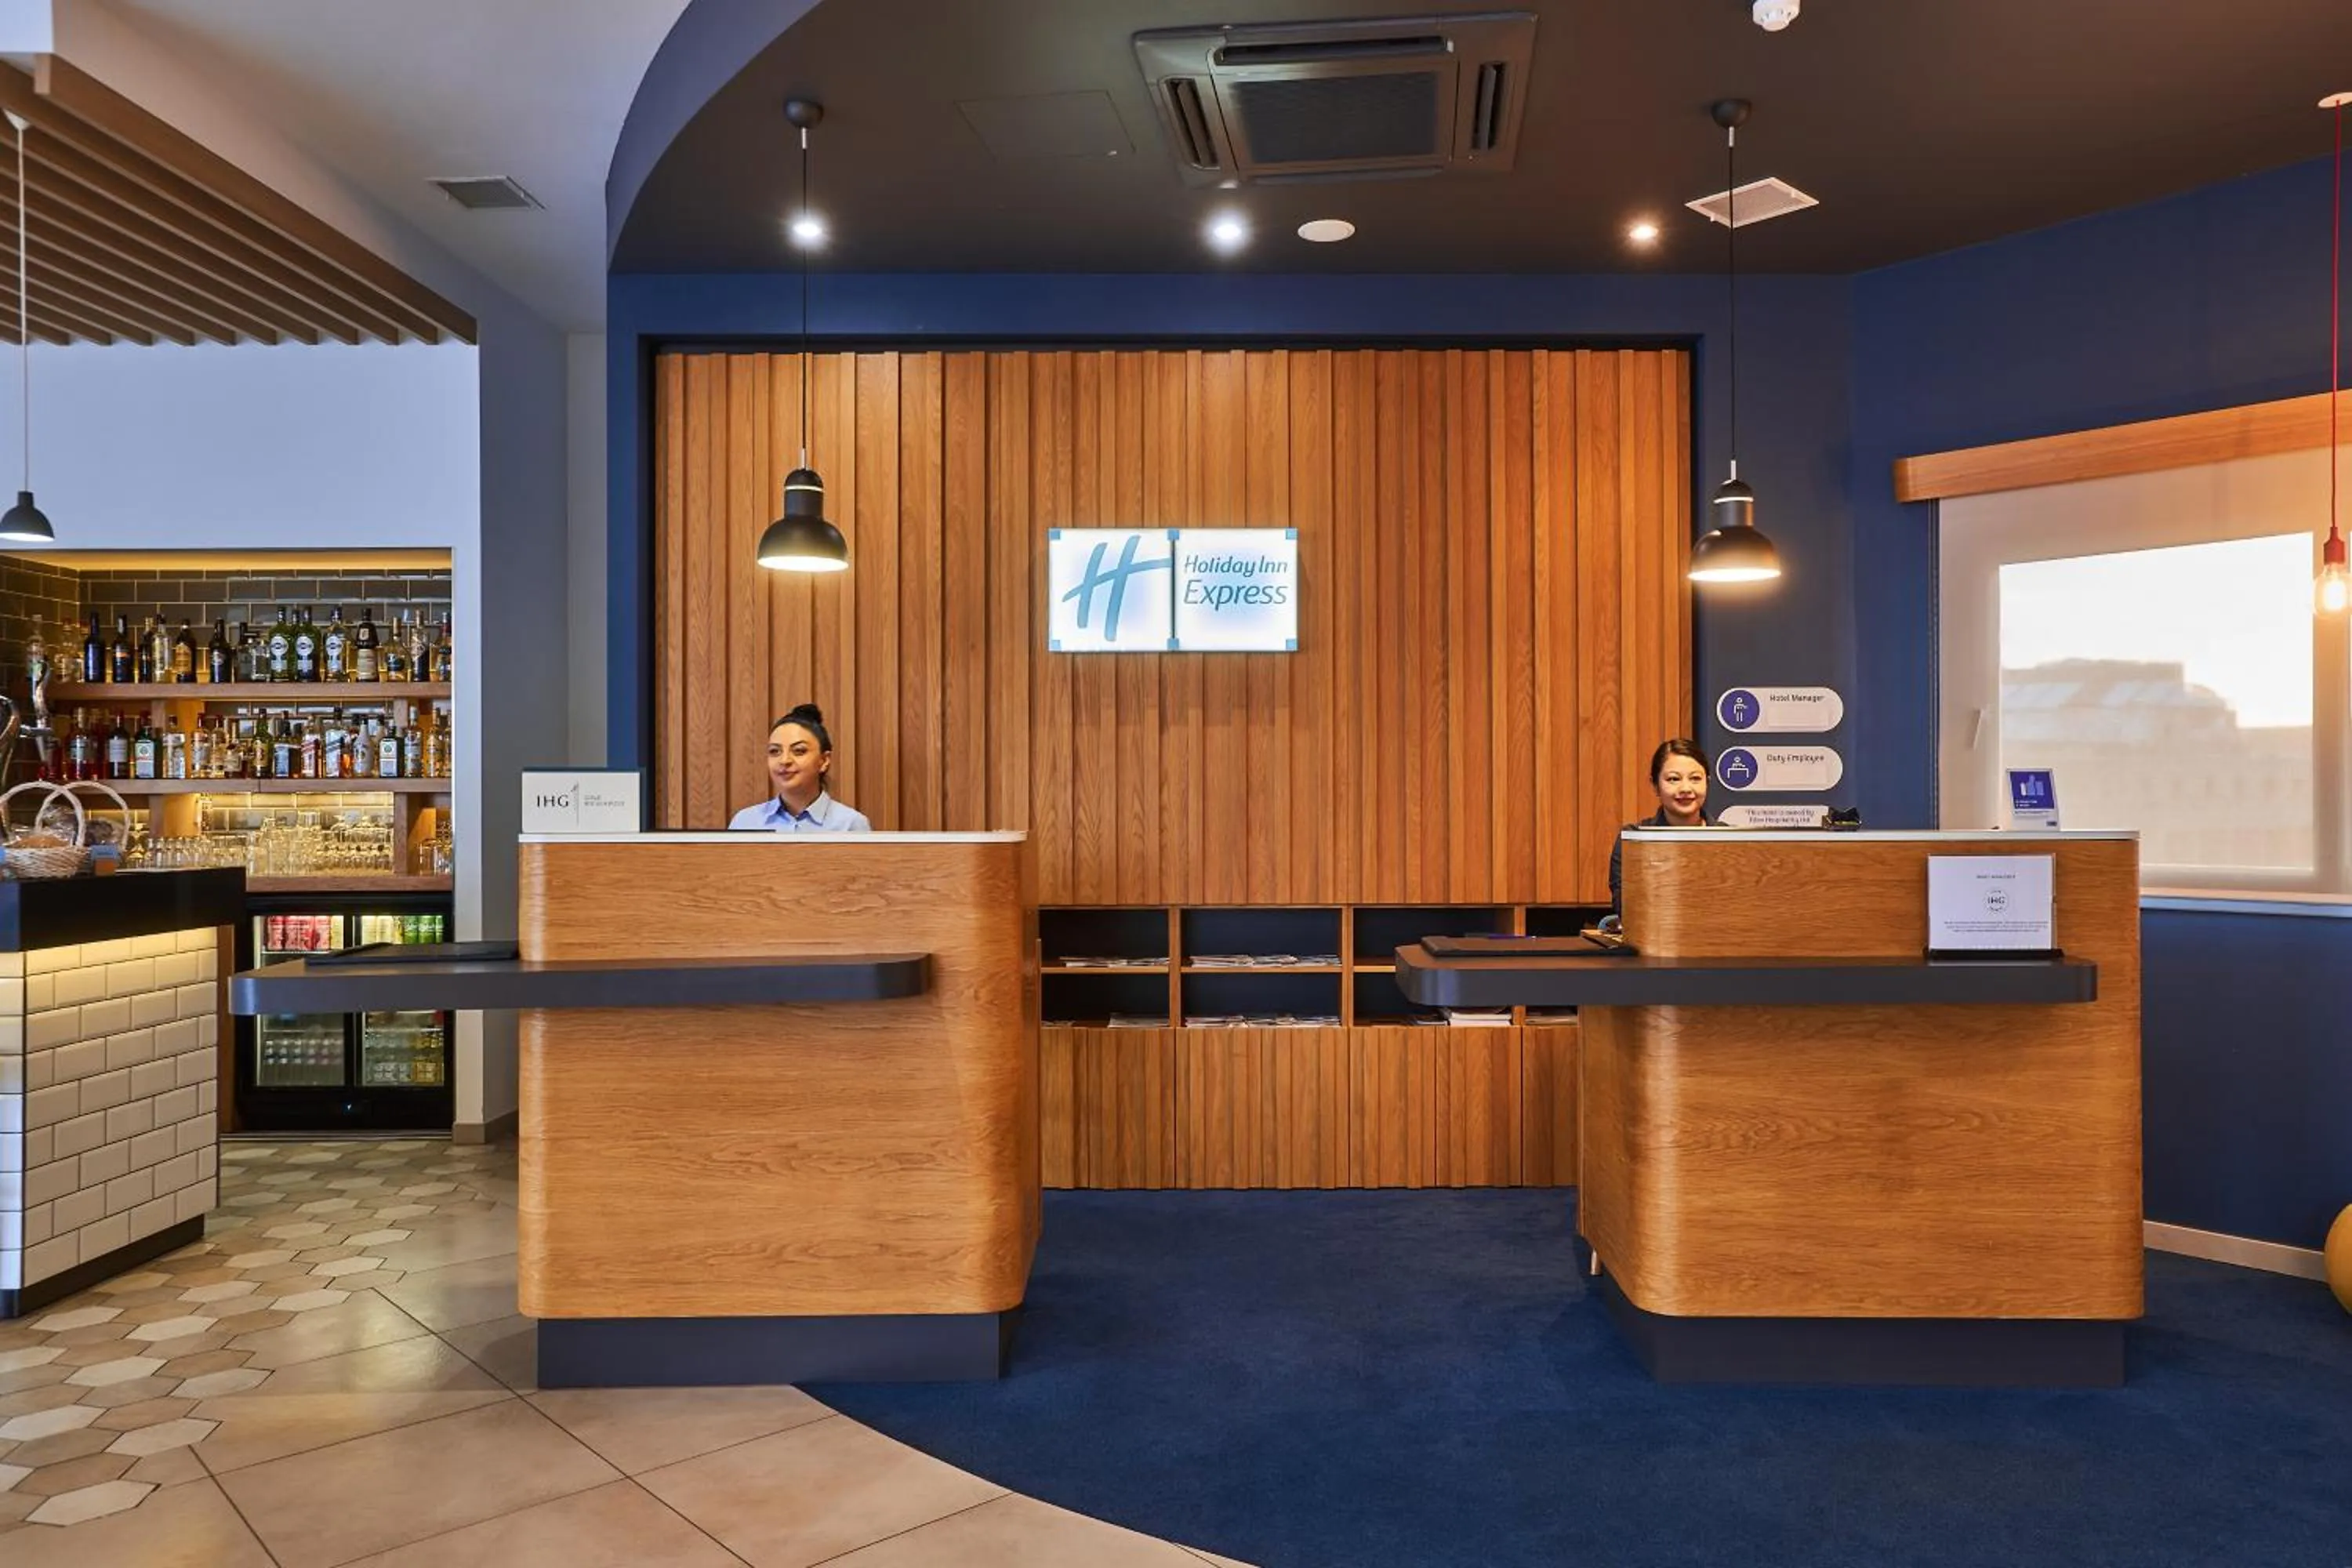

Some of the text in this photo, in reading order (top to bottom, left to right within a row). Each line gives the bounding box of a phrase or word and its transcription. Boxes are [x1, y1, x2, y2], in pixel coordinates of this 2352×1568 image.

[1185, 554, 1287, 578] Holiday Inn
[1183, 579, 1287, 611] Express
[1791, 694, 1824, 702] Manager
[1766, 754, 1825, 764] Duty Employee
[537, 795, 569, 808] IHG
